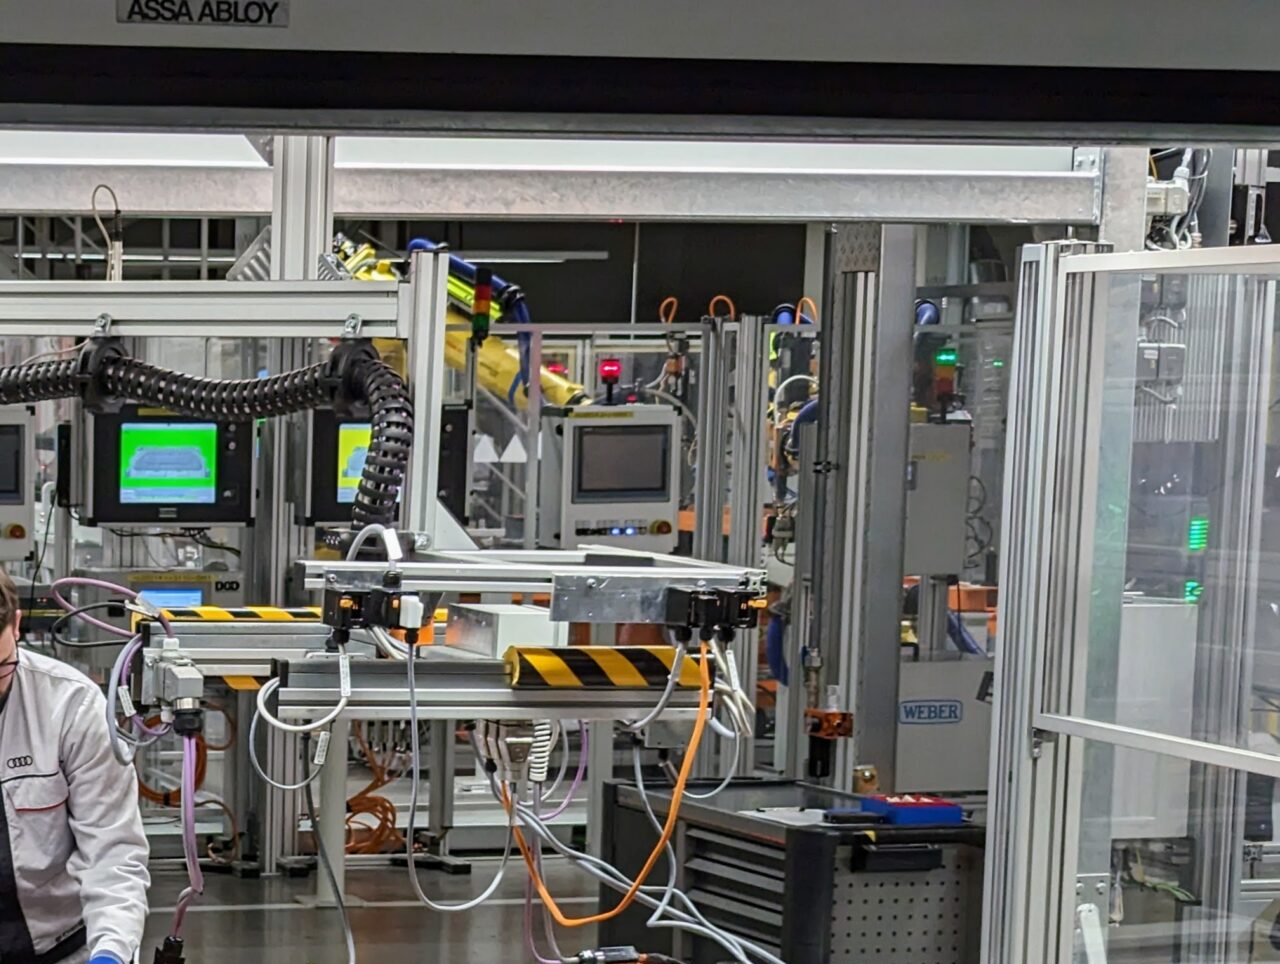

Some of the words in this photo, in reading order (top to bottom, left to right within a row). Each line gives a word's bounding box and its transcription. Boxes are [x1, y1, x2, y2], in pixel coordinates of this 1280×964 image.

[126, 0, 194, 22] ASSA
[197, 1, 280, 24] ABLOY
[903, 704, 959, 720] WEBER
